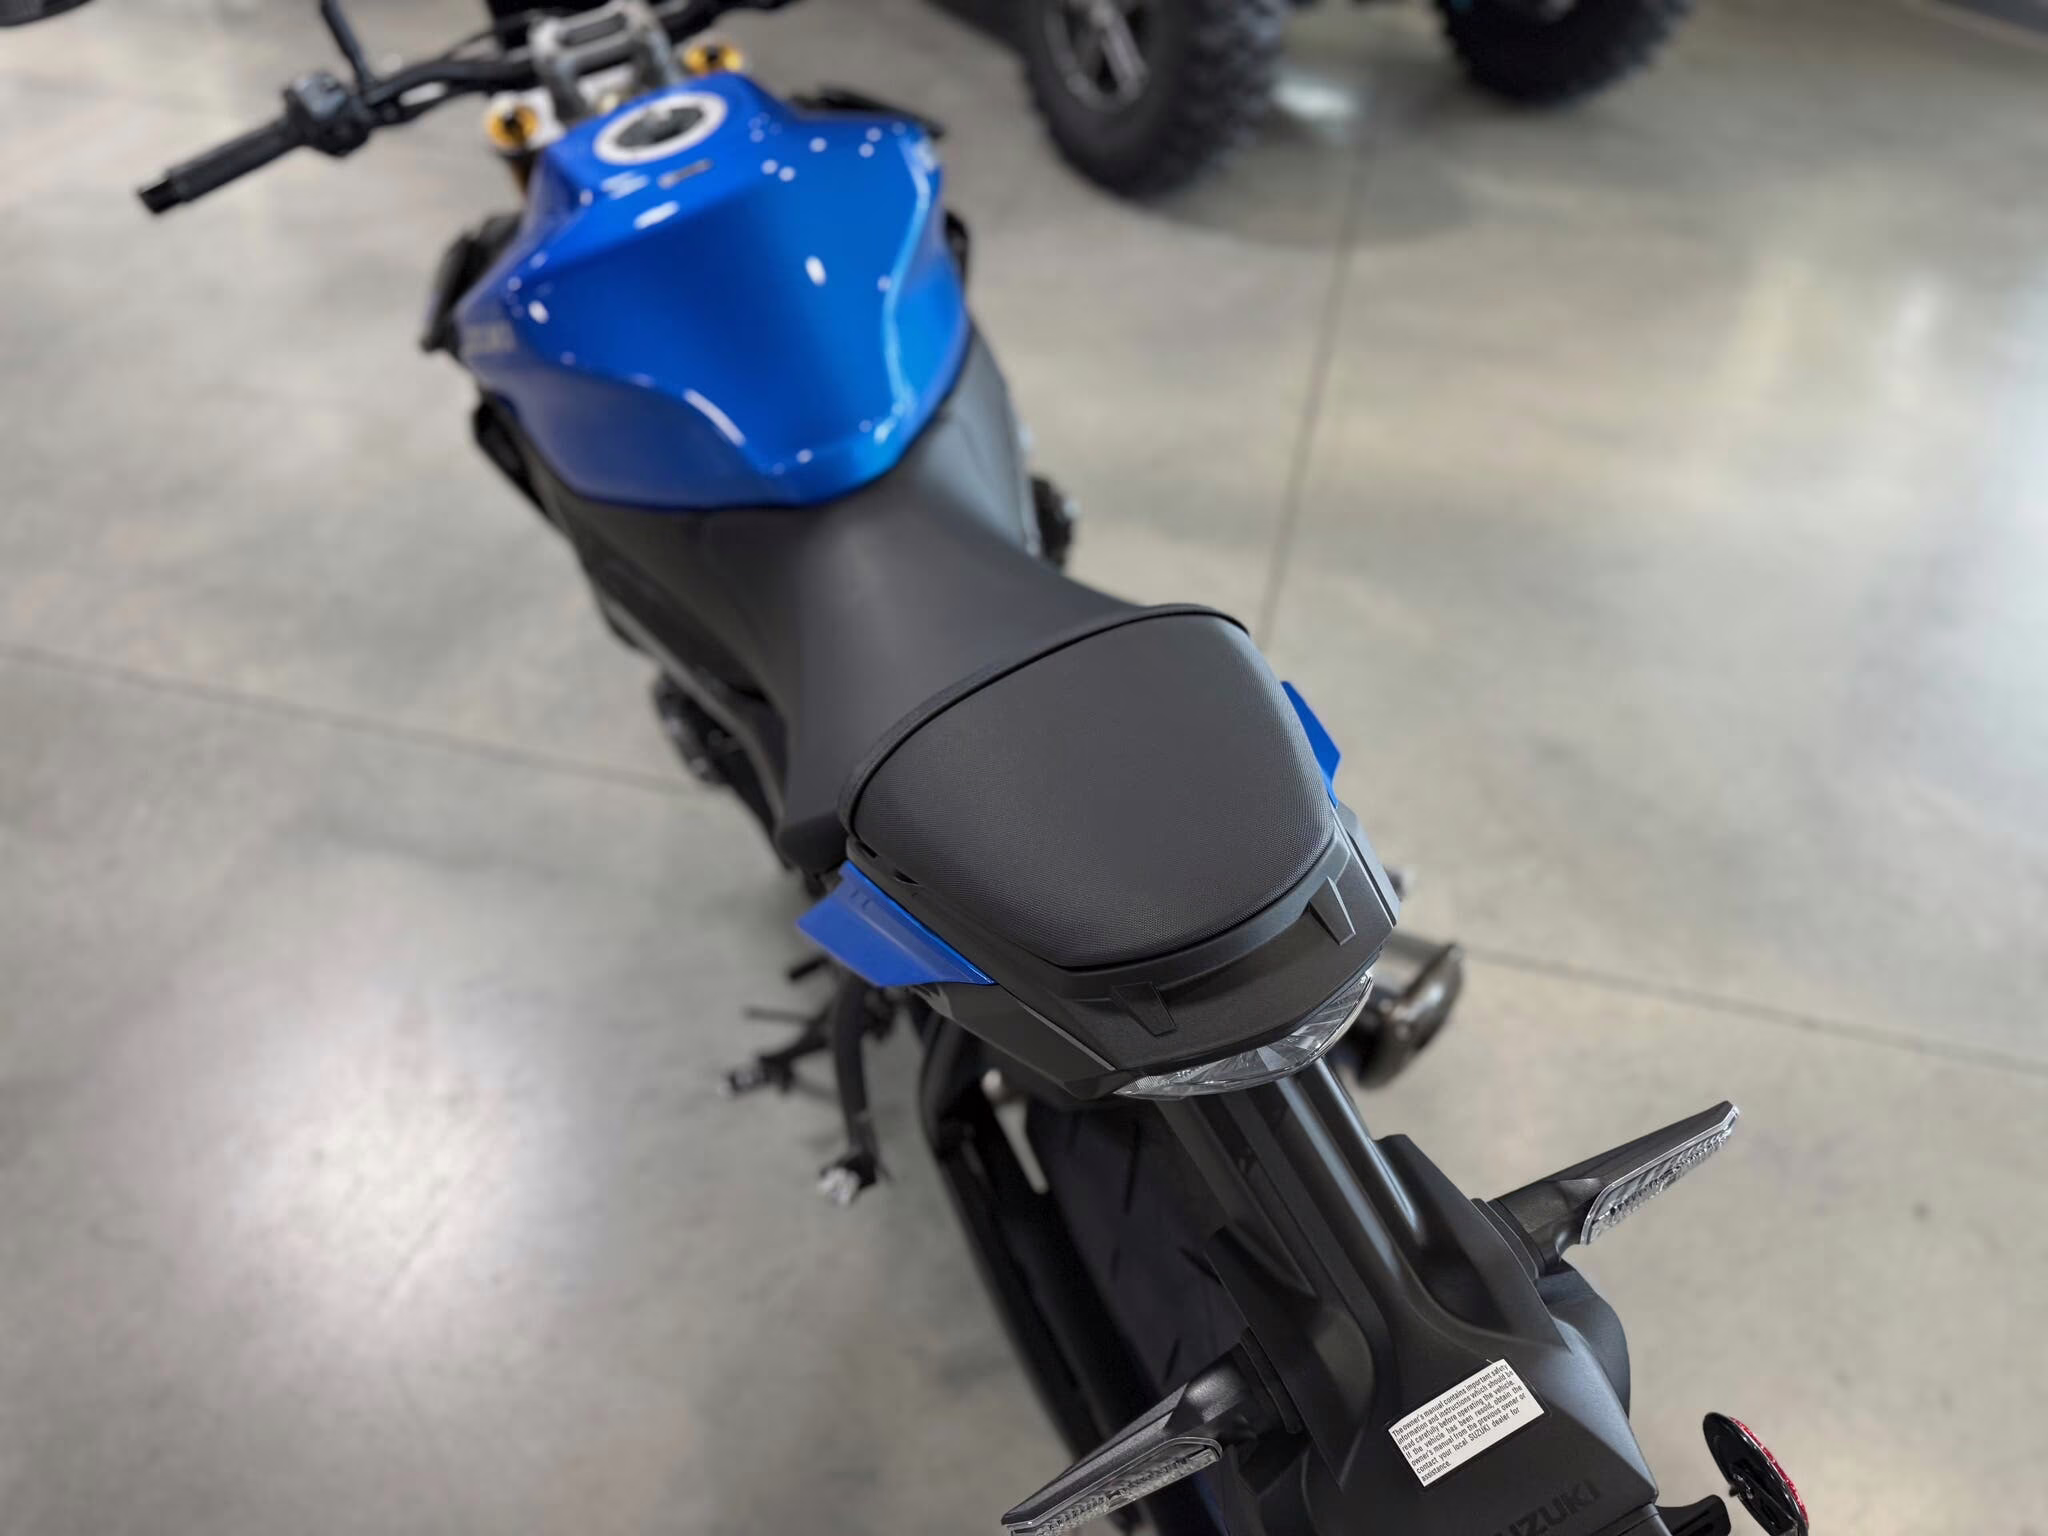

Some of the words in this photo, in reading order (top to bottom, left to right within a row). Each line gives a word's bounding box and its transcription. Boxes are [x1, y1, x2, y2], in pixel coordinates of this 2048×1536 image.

[1396, 1422, 1428, 1444] information
[1437, 1395, 1471, 1418] instructions
[1469, 1385, 1488, 1398] which
[1487, 1373, 1506, 1388] should
[1401, 1438, 1415, 1451] read
[1414, 1425, 1439, 1443] carefully
[1437, 1414, 1457, 1428] before
[1456, 1398, 1484, 1417] operating
[1402, 1414, 1424, 1430] owner's
[1423, 1400, 1444, 1417] manual
[1443, 1388, 1466, 1404] contains
[1464, 1372, 1491, 1391] important
[1424, 1432, 1444, 1447] vehicle
[1457, 1414, 1473, 1426] been
[1493, 1391, 1511, 1405] obtain
[1411, 1449, 1433, 1466] owner's
[1433, 1435, 1454, 1451] manual
[1452, 1428, 1467, 1439] from
[1477, 1407, 1501, 1426] previous
[1500, 1396, 1518, 1410] owner
[1416, 1457, 1438, 1473] contact
[1438, 1448, 1452, 1461] your
[1452, 1437, 1468, 1450] local
[1467, 1423, 1490, 1441] SUZUKI
[1491, 1413, 1509, 1427] dealer
